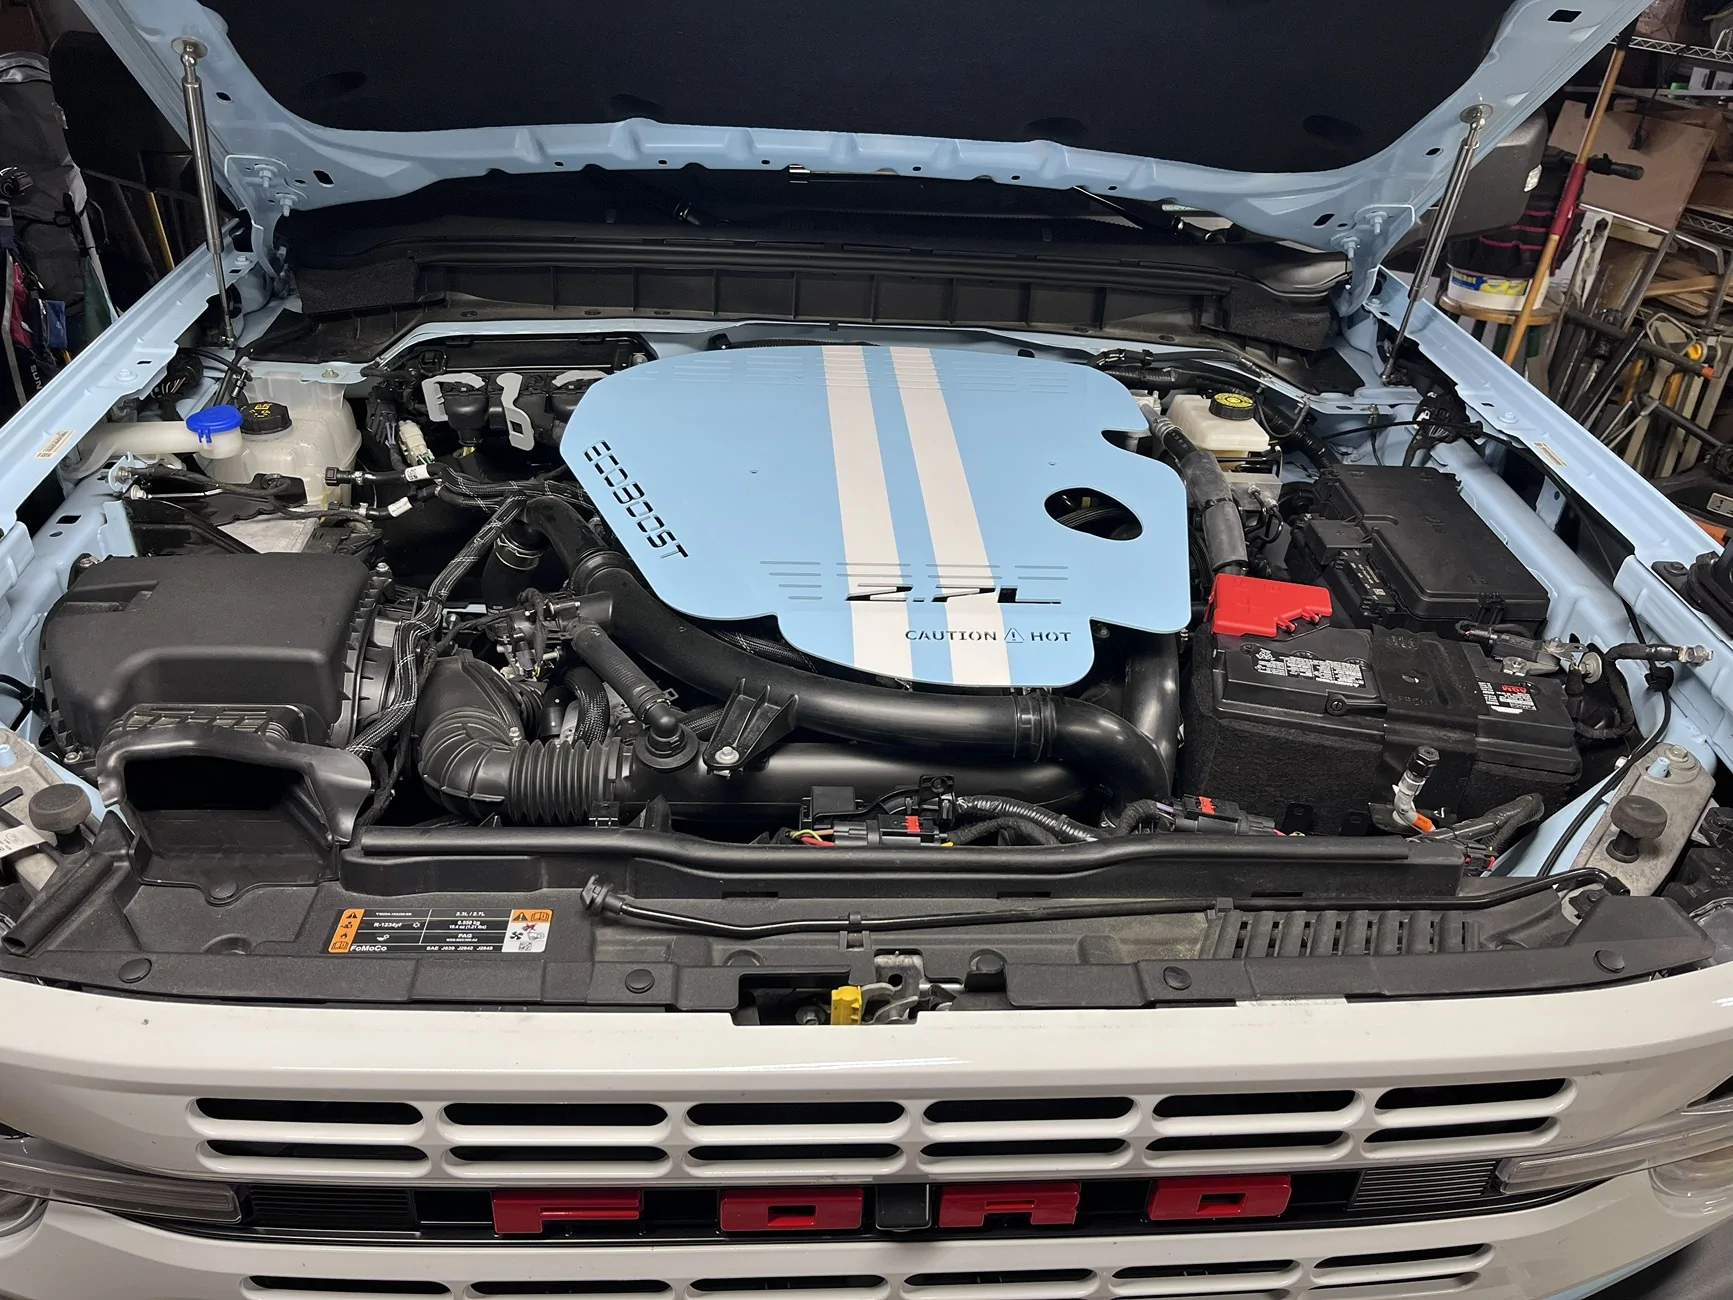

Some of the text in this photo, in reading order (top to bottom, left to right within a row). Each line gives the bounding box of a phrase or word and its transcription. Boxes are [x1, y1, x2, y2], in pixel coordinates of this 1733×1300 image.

[583, 439, 689, 559] ECOBOOST
[845, 583, 1062, 605] 2.7L
[905, 630, 1071, 642] CAUTION HOT
[491, 1174, 1292, 1234] FORD
